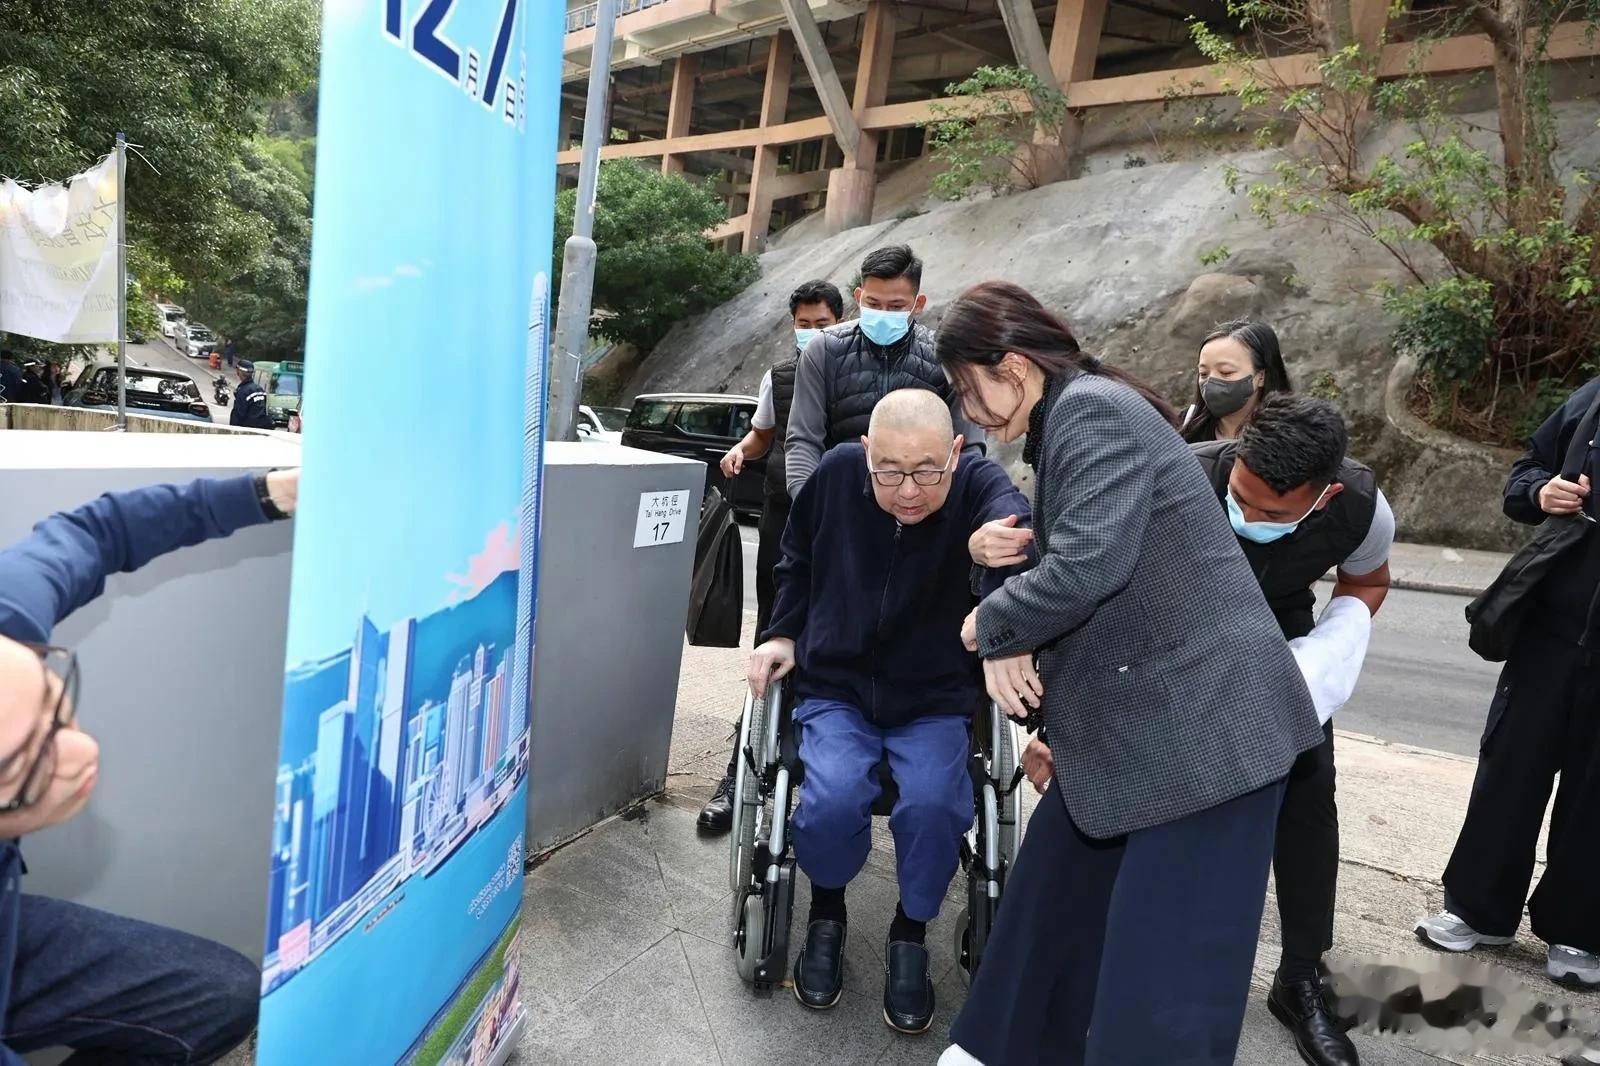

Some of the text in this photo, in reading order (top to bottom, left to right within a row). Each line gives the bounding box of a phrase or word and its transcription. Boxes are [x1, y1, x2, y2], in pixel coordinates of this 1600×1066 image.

[654, 510, 667, 518] Hang
[669, 508, 681, 516] Drive
[653, 522, 670, 541] 17
